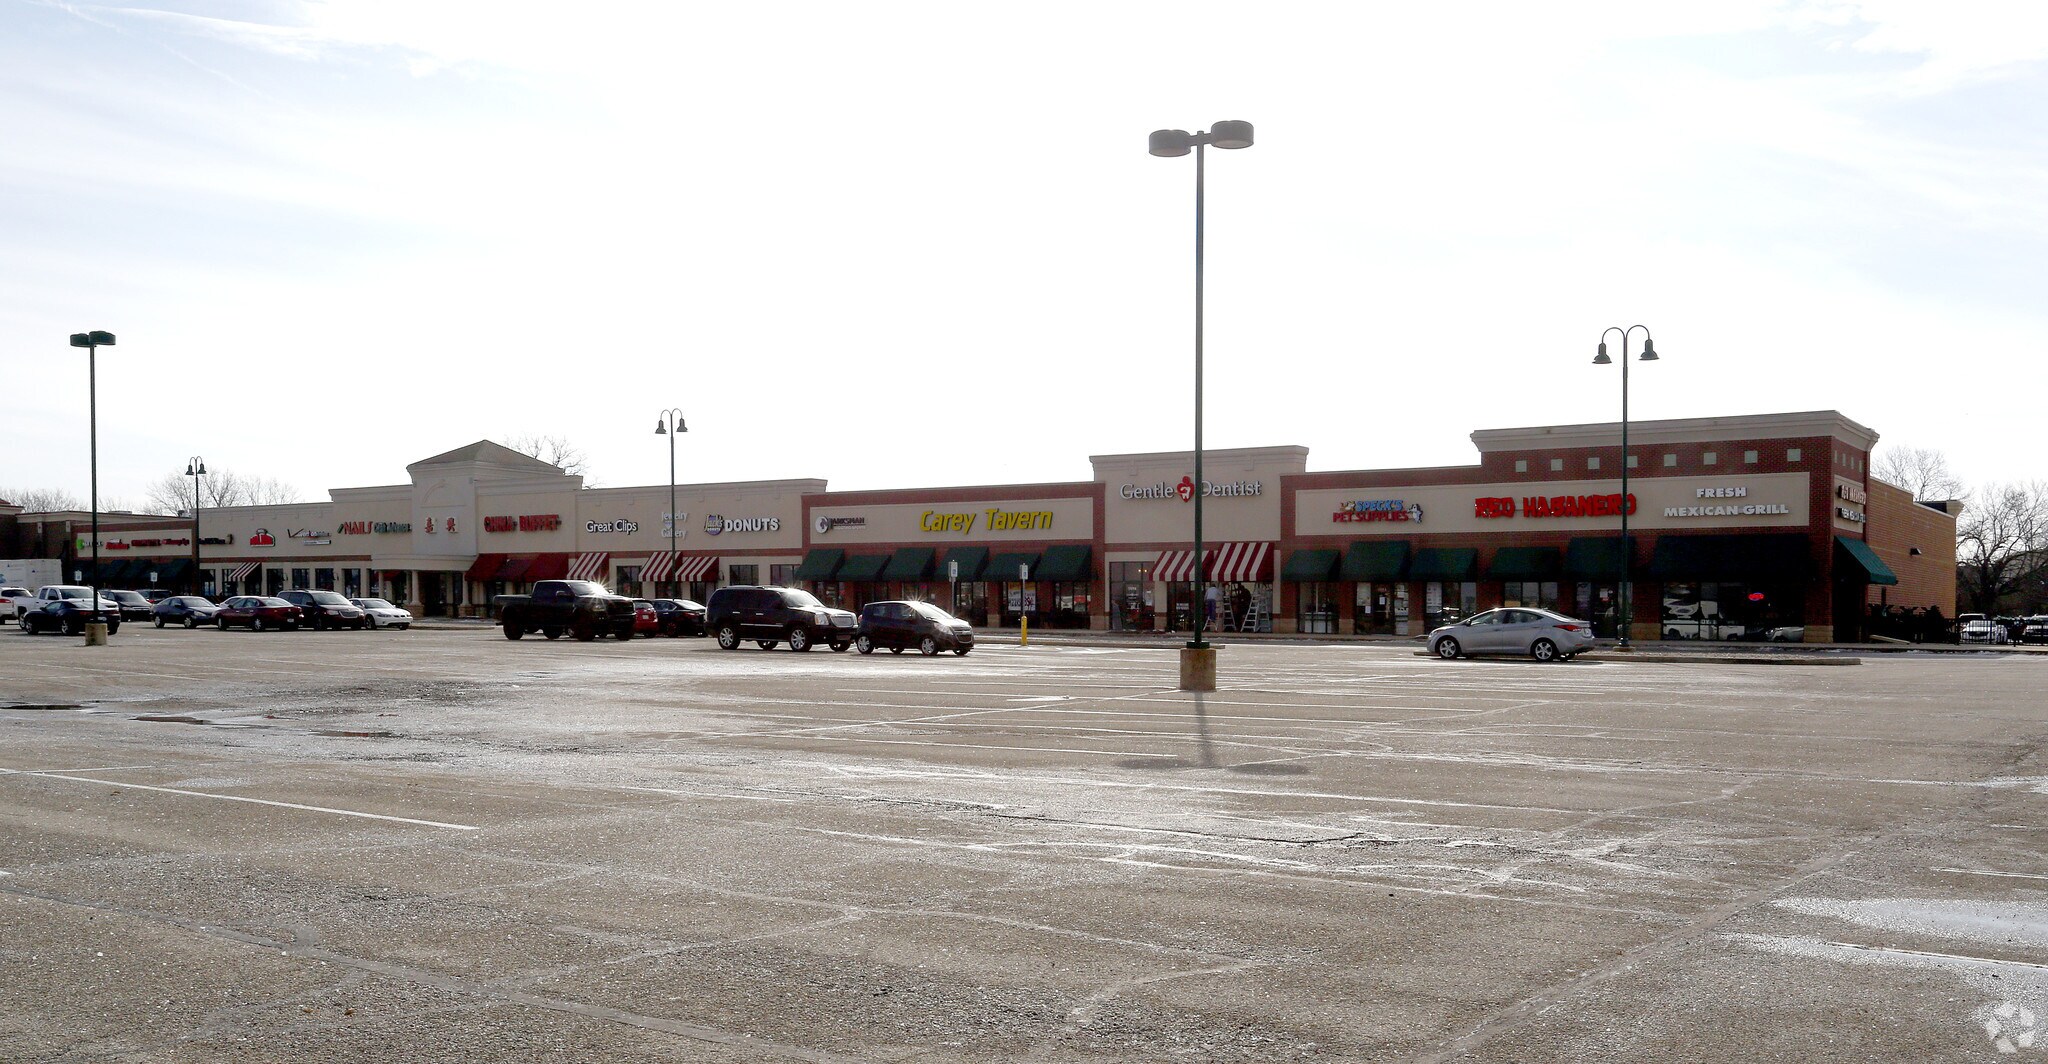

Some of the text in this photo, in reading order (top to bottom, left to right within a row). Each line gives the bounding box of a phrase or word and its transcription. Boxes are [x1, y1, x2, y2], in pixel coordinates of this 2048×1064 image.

[1119, 480, 1263, 500] Gentle Dentist
[1696, 487, 1747, 498] FRESH
[1356, 499, 1404, 512] SPECK'S
[1475, 493, 1637, 518] RED HABANERO
[1663, 504, 1789, 517] MEXICAN GRILL
[919, 508, 1054, 535] Carey Tavern
[1332, 510, 1409, 522] PET SUPPLIES
[343, 521, 373, 534] NAILS
[585, 519, 638, 535] Great Clips
[724, 518, 780, 532] DONUTS
